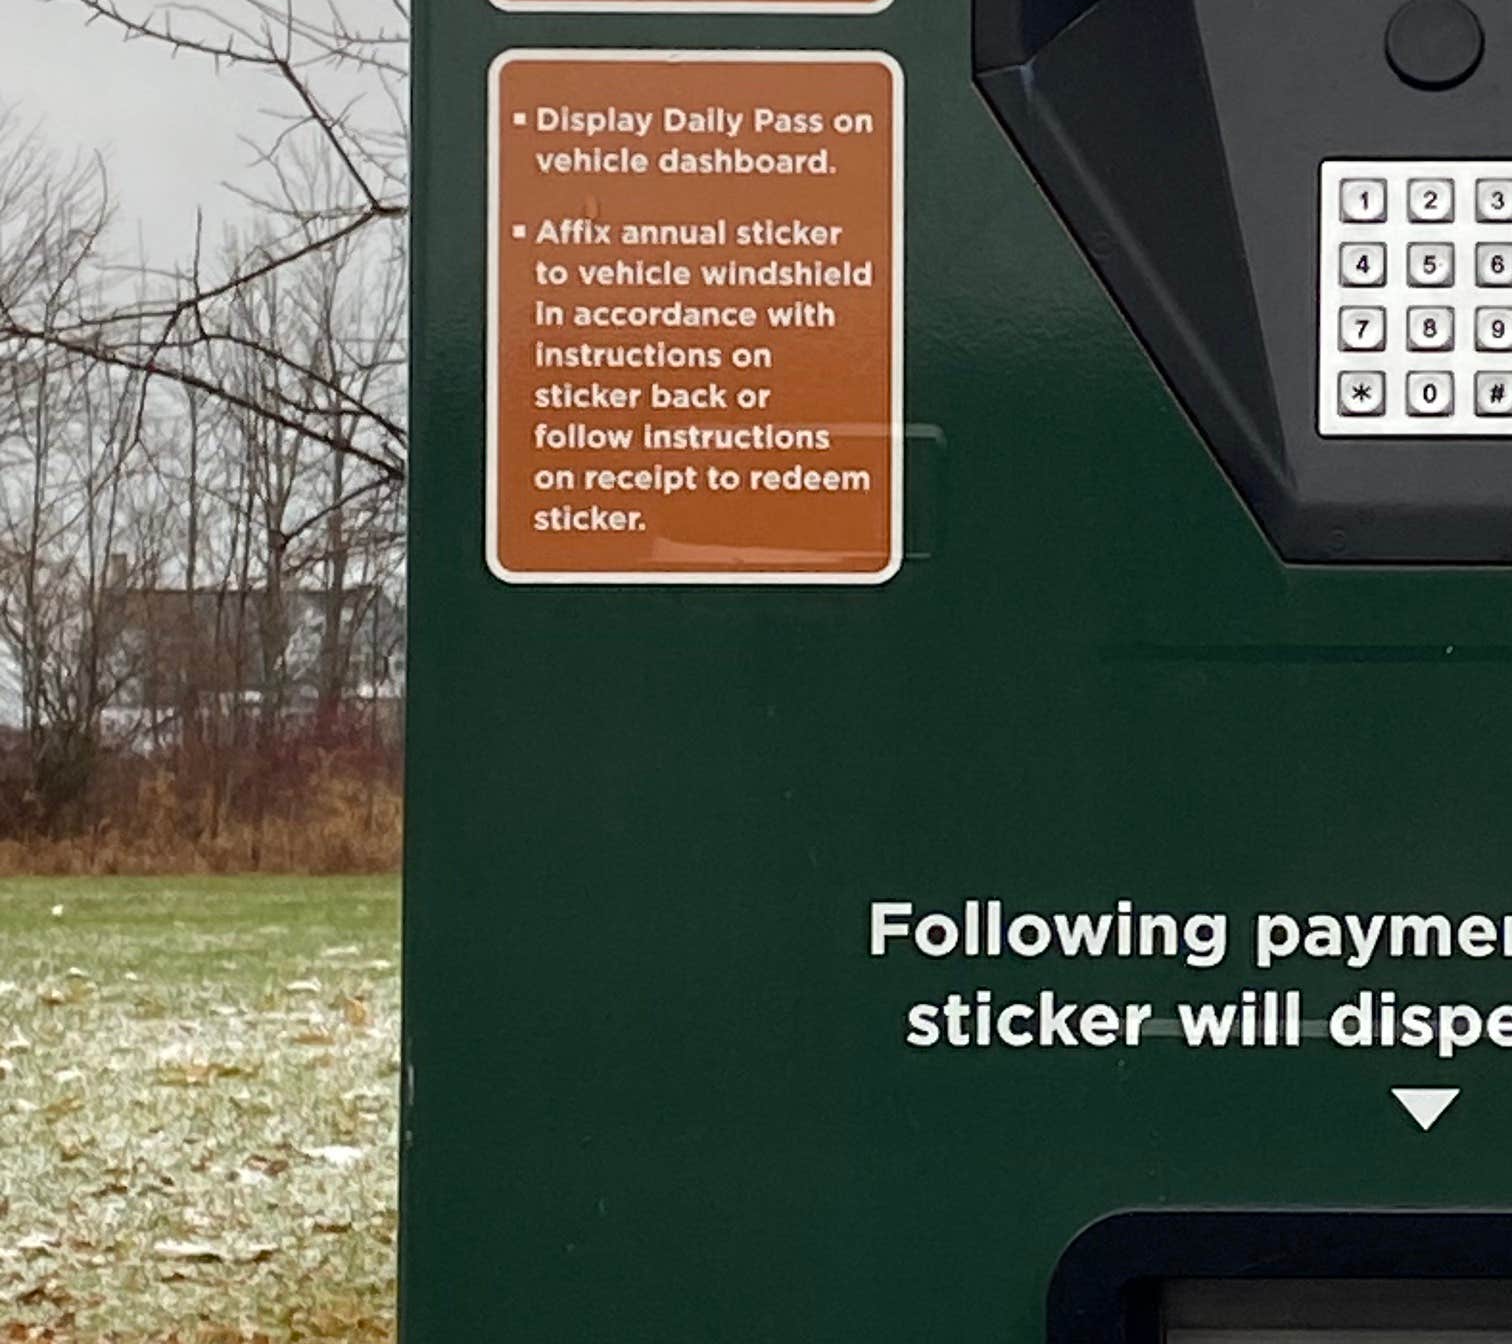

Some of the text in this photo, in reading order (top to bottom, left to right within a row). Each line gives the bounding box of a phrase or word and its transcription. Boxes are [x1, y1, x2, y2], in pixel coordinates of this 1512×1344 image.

[537, 106, 874, 138] Display Daily Pass on
[535, 147, 836, 174] vehicle dashboard.
[1360, 191, 1504, 210] 1 2 3
[535, 218, 843, 246] Affix annual sticker
[535, 259, 872, 287] to vehicle windshield
[1356, 255, 1504, 274] 4 5 6
[536, 300, 836, 327] in accordance with
[1355, 319, 1505, 338] 7 8 9
[536, 341, 772, 368] instructions on
[534, 382, 771, 409] sticker back or
[1424, 384, 1436, 403] 0
[1490, 384, 1504, 403] #
[534, 423, 830, 450] follow instructions
[534, 464, 870, 495] on receipt to redeem
[534, 505, 646, 531] sticker.
[871, 900, 1227, 967] Following
[907, 992, 1152, 1048] sticker
[1179, 992, 1300, 1047] will
